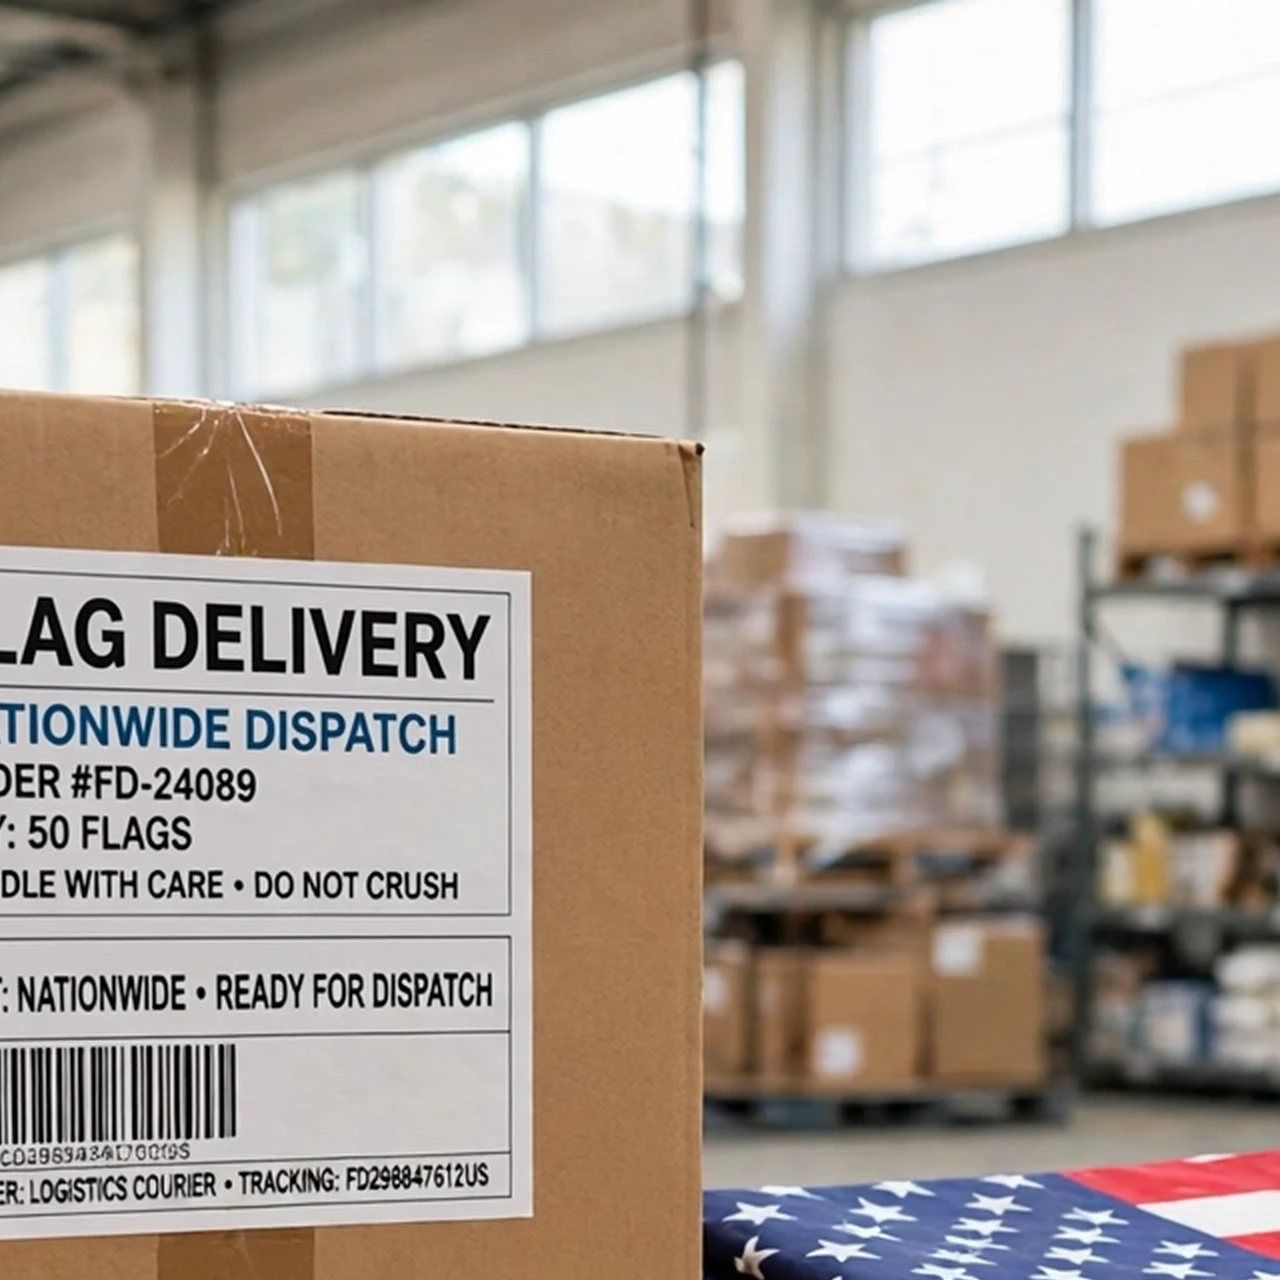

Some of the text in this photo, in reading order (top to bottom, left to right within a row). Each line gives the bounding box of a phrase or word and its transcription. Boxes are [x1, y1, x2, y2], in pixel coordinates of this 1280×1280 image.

[153, 600, 491, 680] DELIVERY
[247, 709, 455, 754] DISPATCH
[71, 764, 256, 803] #FD-24089
[28, 815, 69, 850] 50
[82, 815, 192, 851] FLAGS
[64, 870, 138, 898] WITH
[148, 870, 223, 899] CARE
[255, 871, 294, 899] DO
[303, 871, 359, 899] NOT
[366, 871, 458, 900] CRUSH
[18, 974, 186, 1012] NATIONWIDE
[216, 973, 305, 1010] READY
[313, 973, 365, 1008] FOR
[373, 972, 492, 1008] DISPATCH
[30, 1175, 128, 1204] LOGISTICS
[133, 1172, 216, 1200] COURIER
[238, 1167, 339, 1195] TRACKING:
[346, 1162, 489, 1191] FD298847612US
